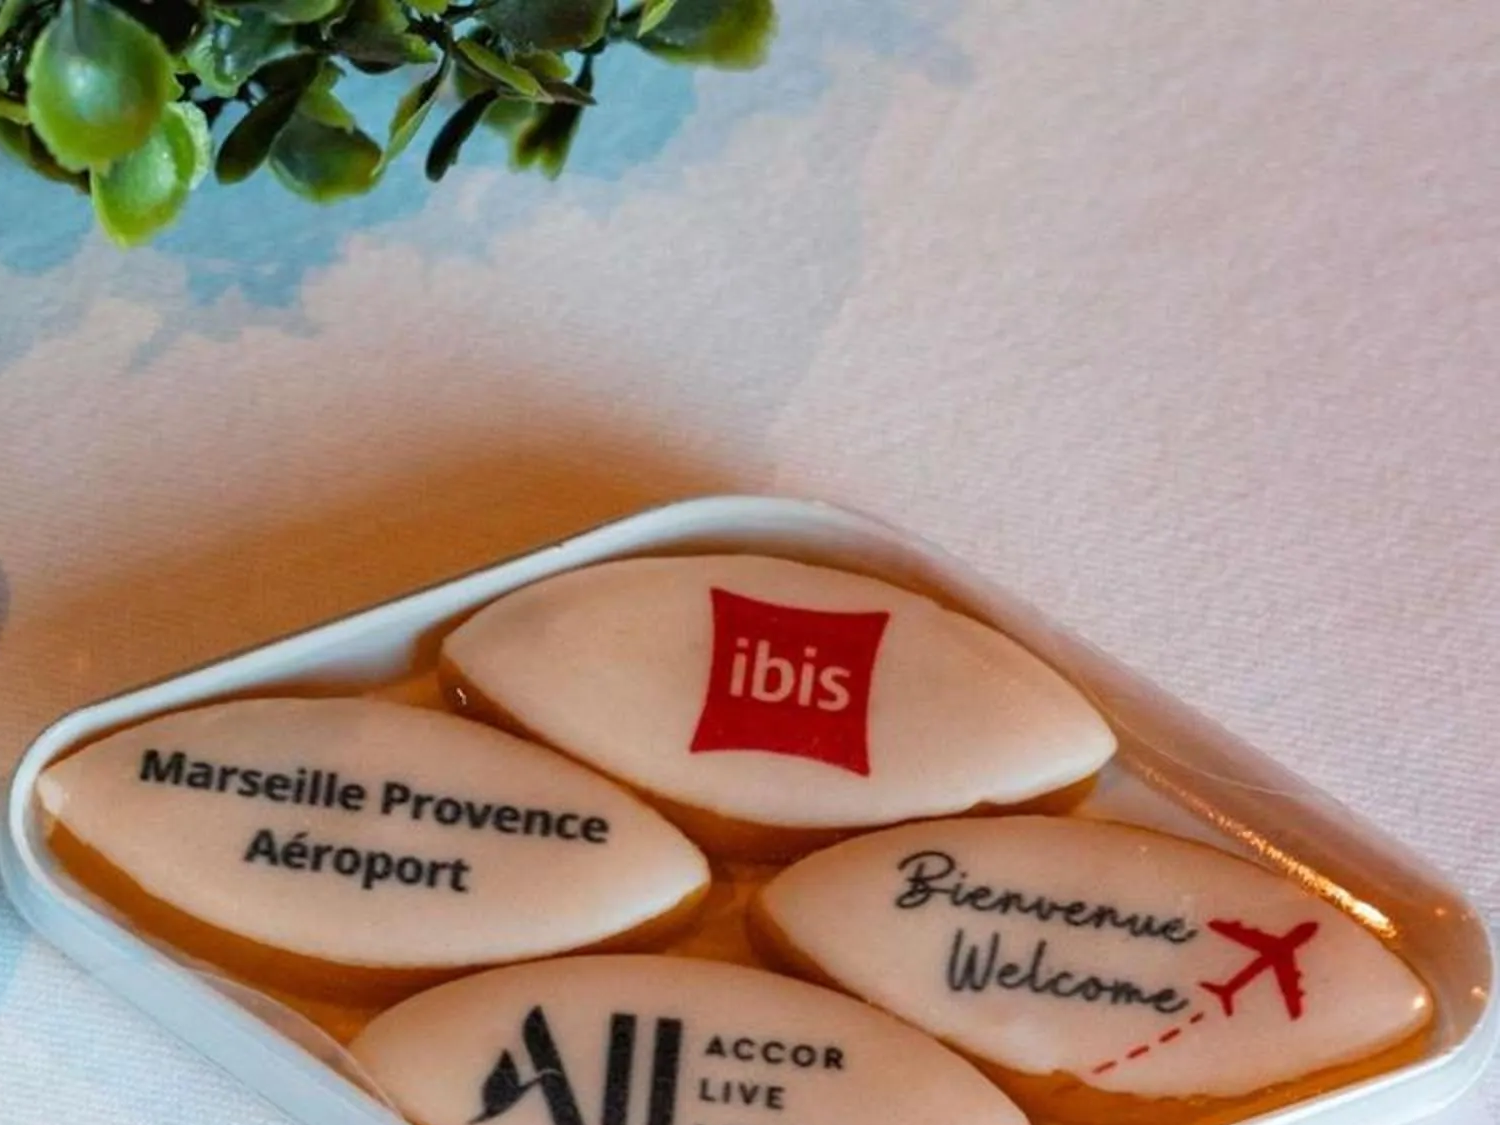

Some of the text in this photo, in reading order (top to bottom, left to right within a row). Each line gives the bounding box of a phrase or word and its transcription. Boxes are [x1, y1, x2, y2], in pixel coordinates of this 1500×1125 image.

[729, 636, 851, 712] ibis
[138, 748, 609, 844] Marseille Provence
[244, 828, 471, 893] Aéroport
[895, 850, 1197, 944] Bienvenue
[947, 928, 1189, 1013] Welcome
[704, 1035, 845, 1070] ACCOR
[699, 1077, 786, 1110] LIVE
